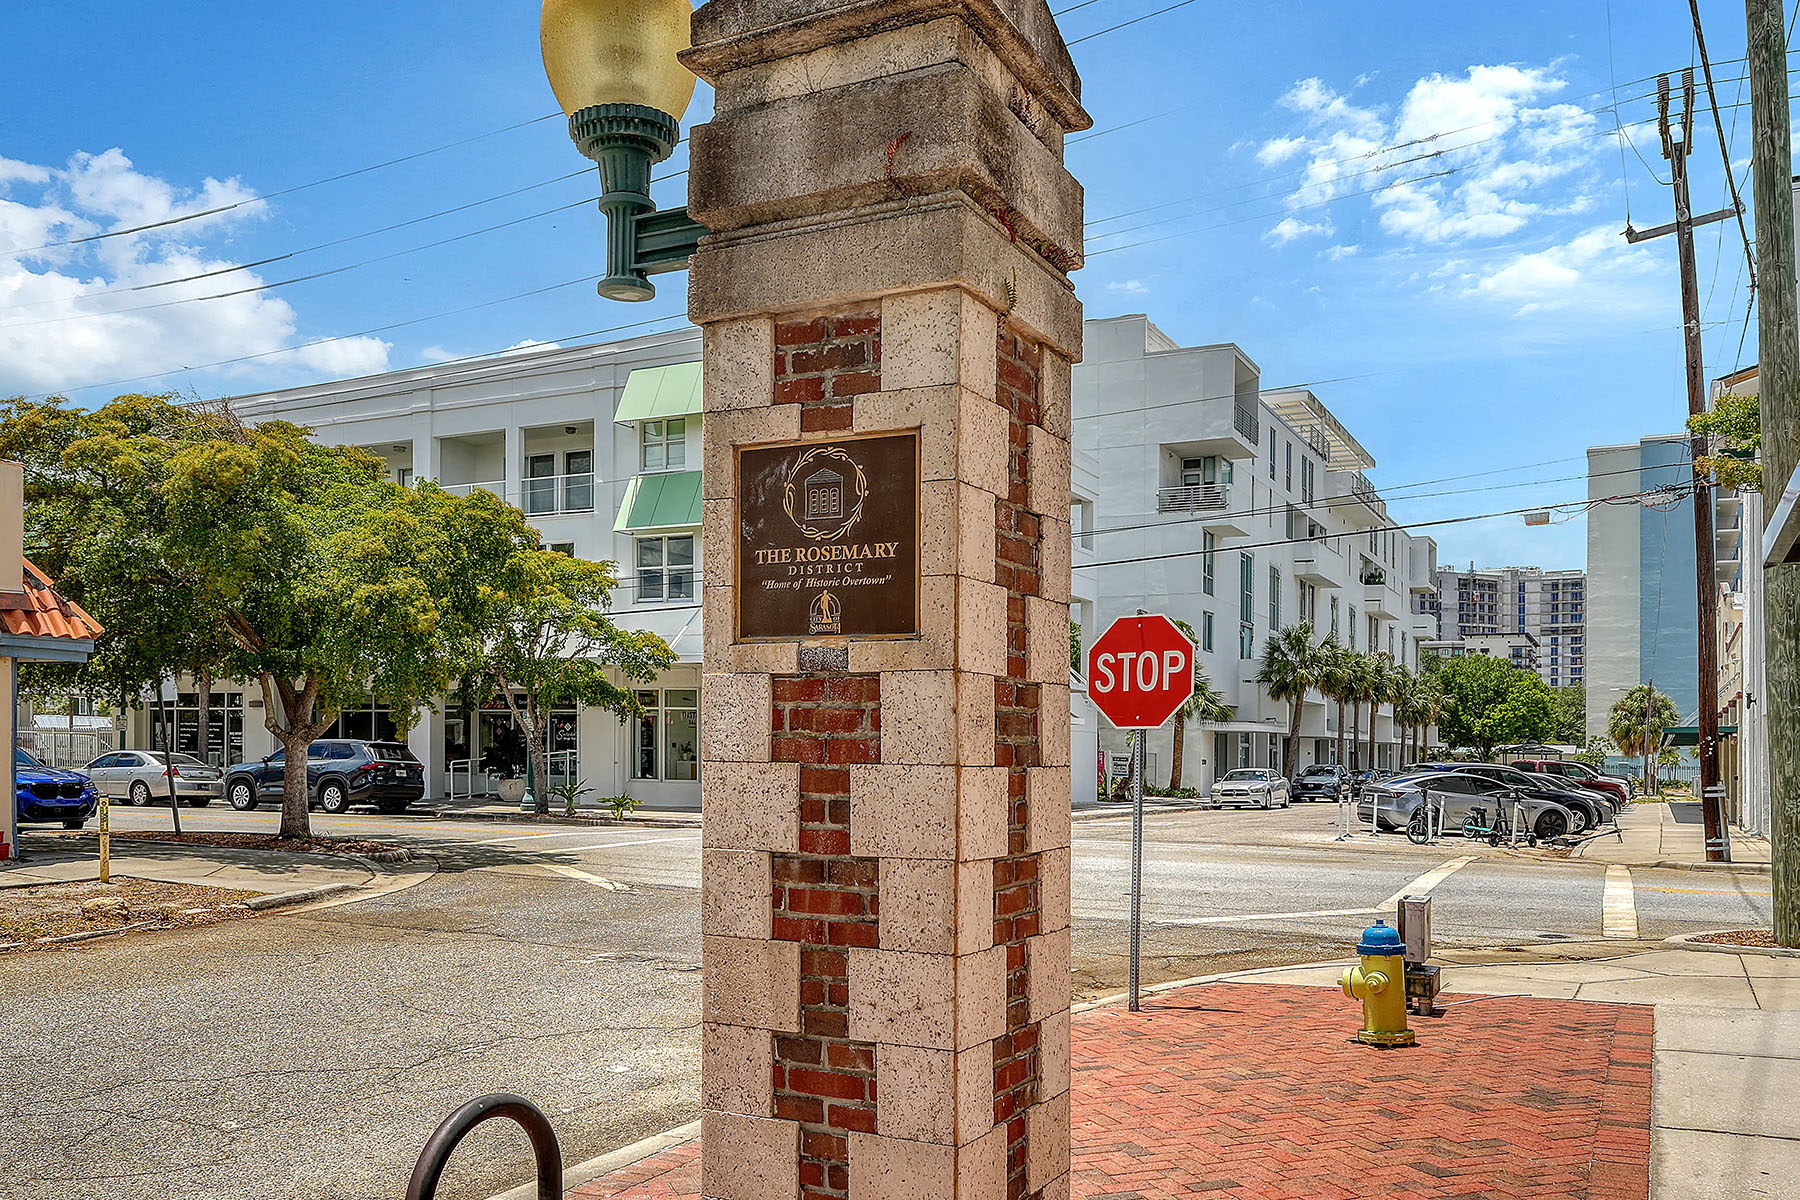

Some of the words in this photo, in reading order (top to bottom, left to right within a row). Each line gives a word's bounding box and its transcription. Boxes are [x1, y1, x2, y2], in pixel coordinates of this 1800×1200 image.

[755, 548, 792, 565] THE
[795, 542, 900, 563] ROSEMARY
[788, 562, 865, 576] DISTRICT
[792, 578, 803, 591] of
[804, 577, 841, 589] Historic
[1095, 650, 1185, 693] STOP
